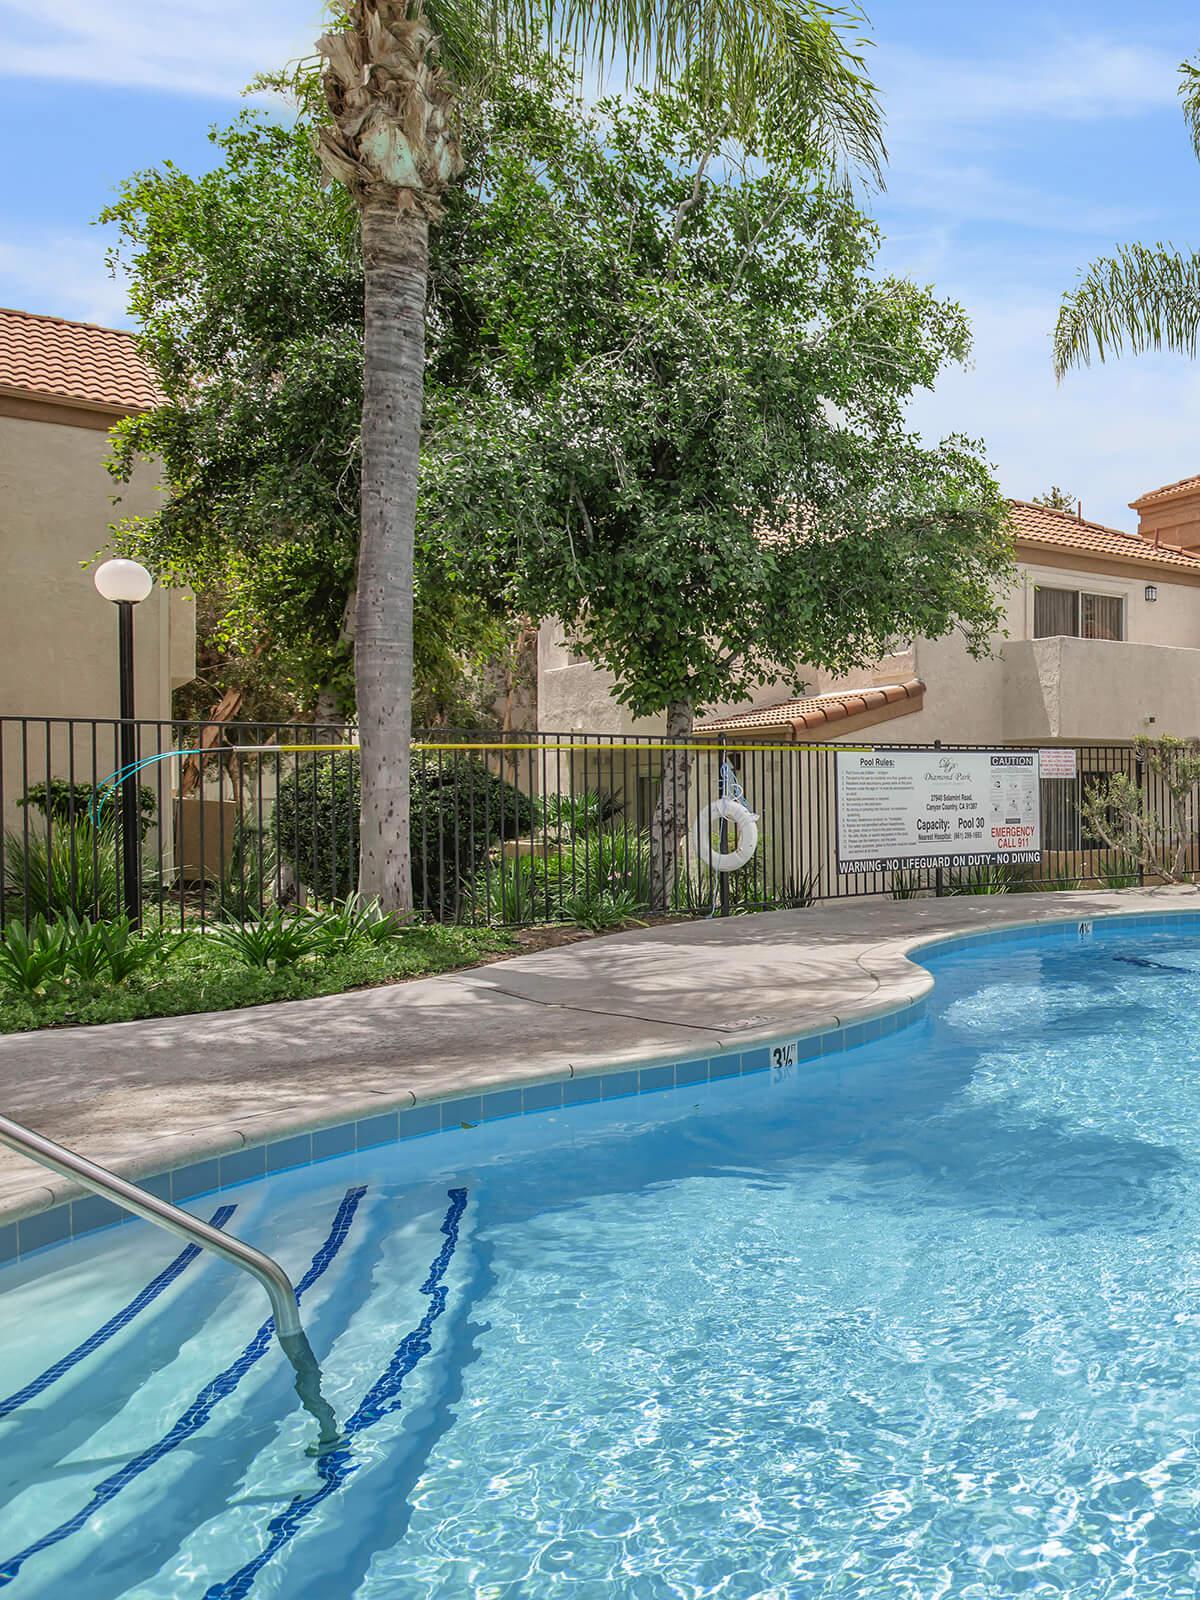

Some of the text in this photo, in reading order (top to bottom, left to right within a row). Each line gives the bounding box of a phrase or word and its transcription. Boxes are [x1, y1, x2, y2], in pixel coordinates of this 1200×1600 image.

[860, 757, 896, 767] Pool Rules:
[992, 757, 1032, 765] CAUTION
[924, 772, 953, 781] Diamond
[956, 772, 973, 782] Park
[959, 802, 965, 810] CA
[916, 818, 951, 833] Capacity:
[958, 817, 975, 829] Pool
[976, 817, 985, 829] 30
[991, 826, 1035, 837] EMERGENCY
[998, 837, 1029, 849] CALL 911
[901, 856, 950, 870] LIFEGUARD
[952, 855, 966, 867] ON
[1012, 851, 1041, 864] DIVING
